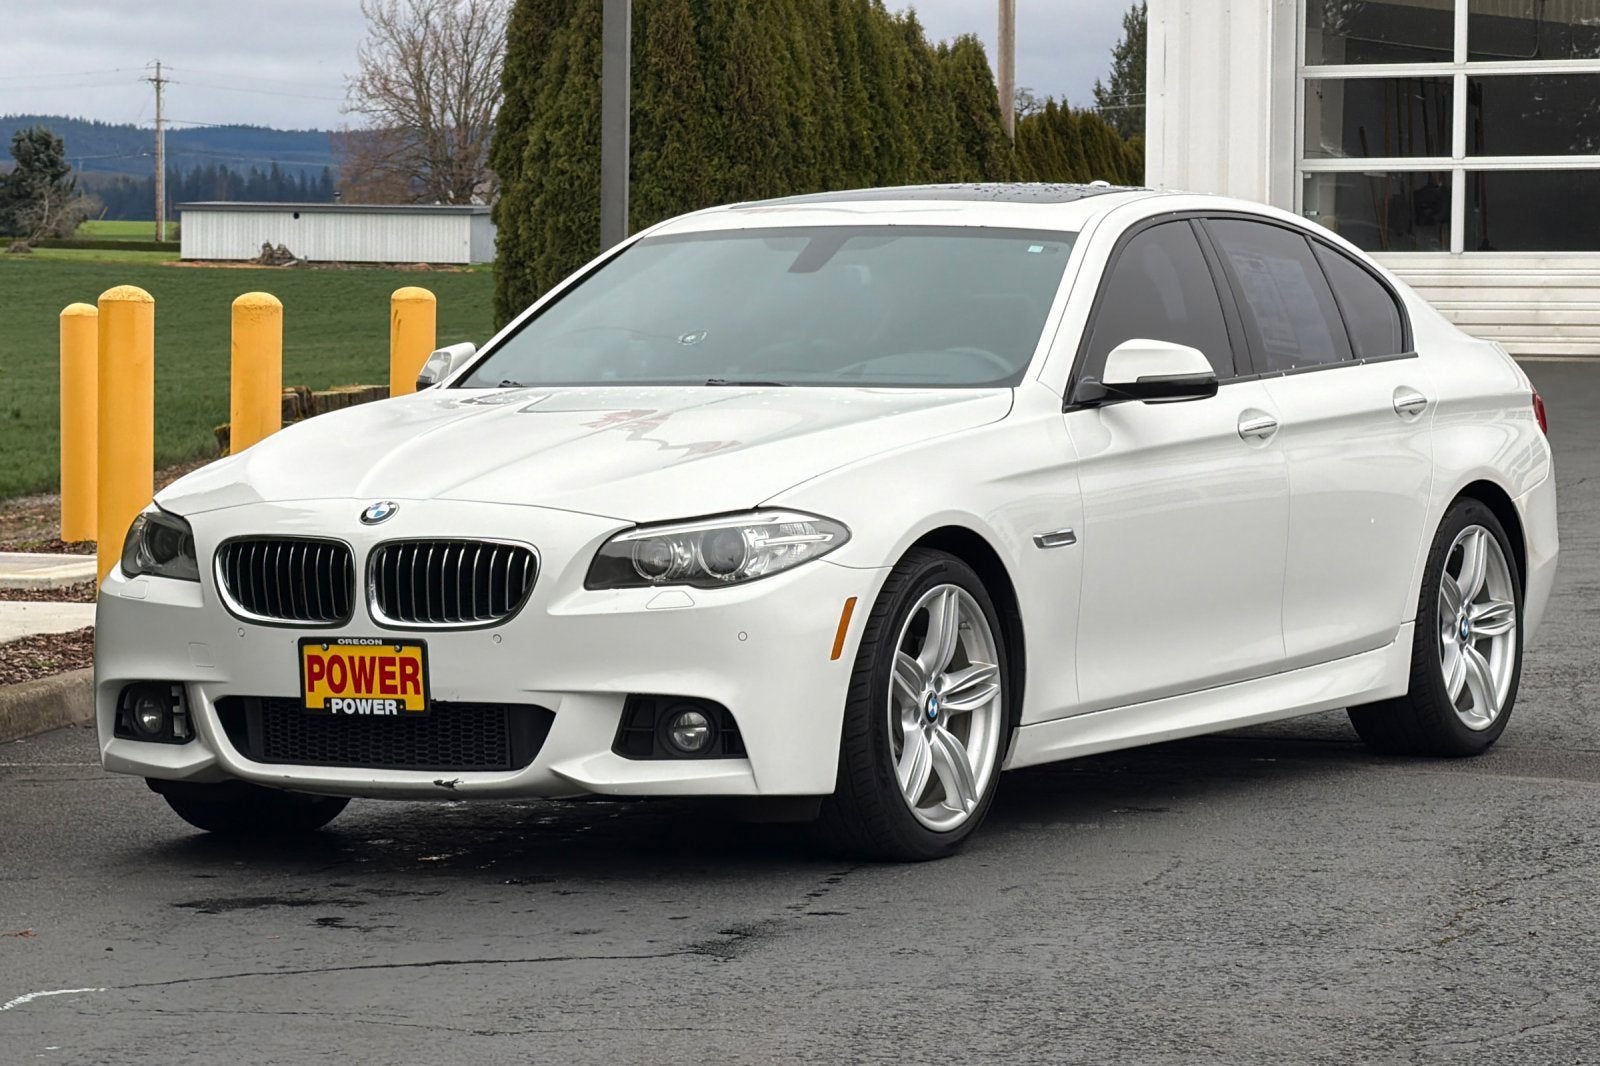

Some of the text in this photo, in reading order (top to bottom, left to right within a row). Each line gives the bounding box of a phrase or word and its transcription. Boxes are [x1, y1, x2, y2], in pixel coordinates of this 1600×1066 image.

[337, 638, 383, 646] OREGON
[307, 654, 421, 695] POWER
[331, 698, 398, 715] POWER
